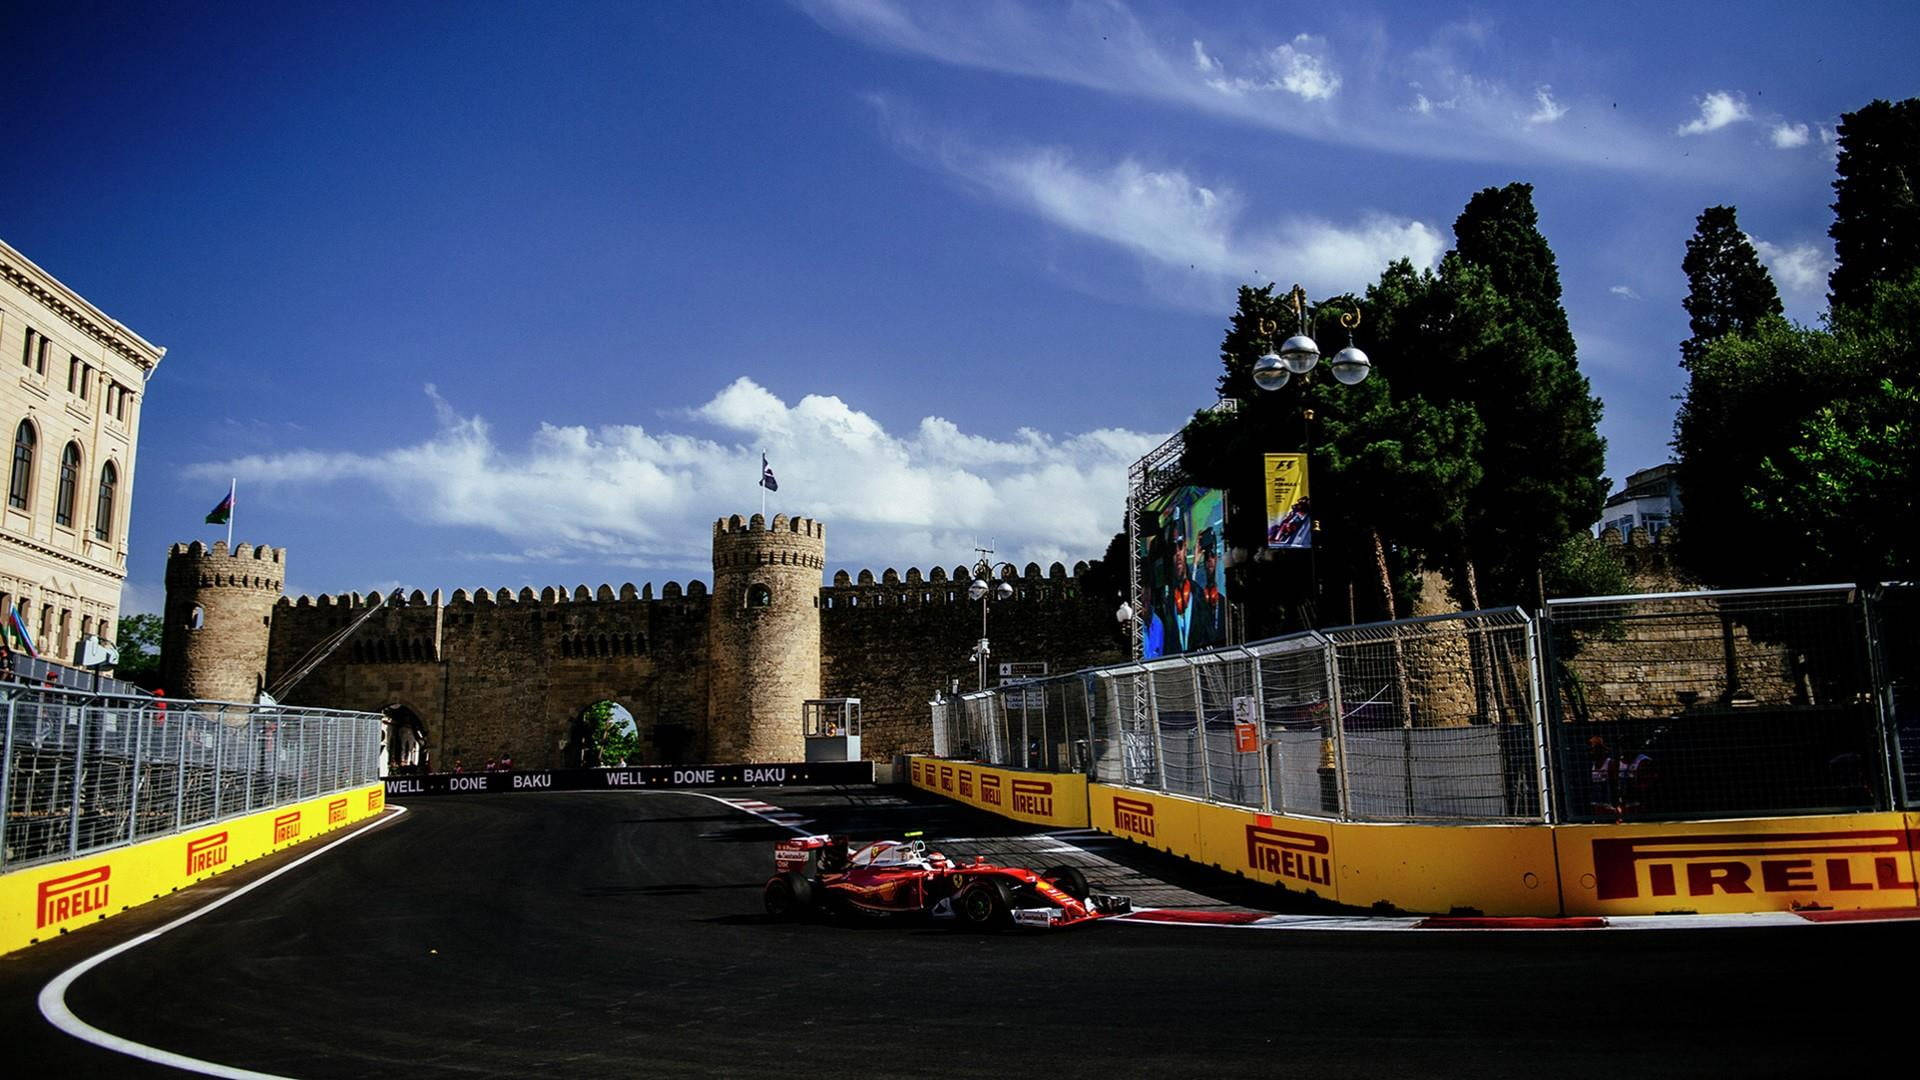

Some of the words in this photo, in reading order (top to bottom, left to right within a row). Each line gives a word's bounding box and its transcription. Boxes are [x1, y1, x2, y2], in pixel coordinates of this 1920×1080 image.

[1240, 728, 1251, 748] F
[387, 780, 424, 793] WELL
[450, 777, 487, 790] DONE
[513, 774, 551, 788] BAKU
[606, 773, 646, 785] WELL
[674, 770, 715, 783] DONE
[744, 768, 786, 782] BAKU
[1012, 779, 1053, 817] PIRELLI
[1113, 796, 1155, 838] PIRELLI
[274, 811, 301, 845] PIRELLI
[186, 831, 228, 876] PIRELLI
[1245, 824, 1331, 886] PIRELLI
[1592, 829, 1920, 900] PIRELL
[36, 865, 111, 929] PIRELLI
